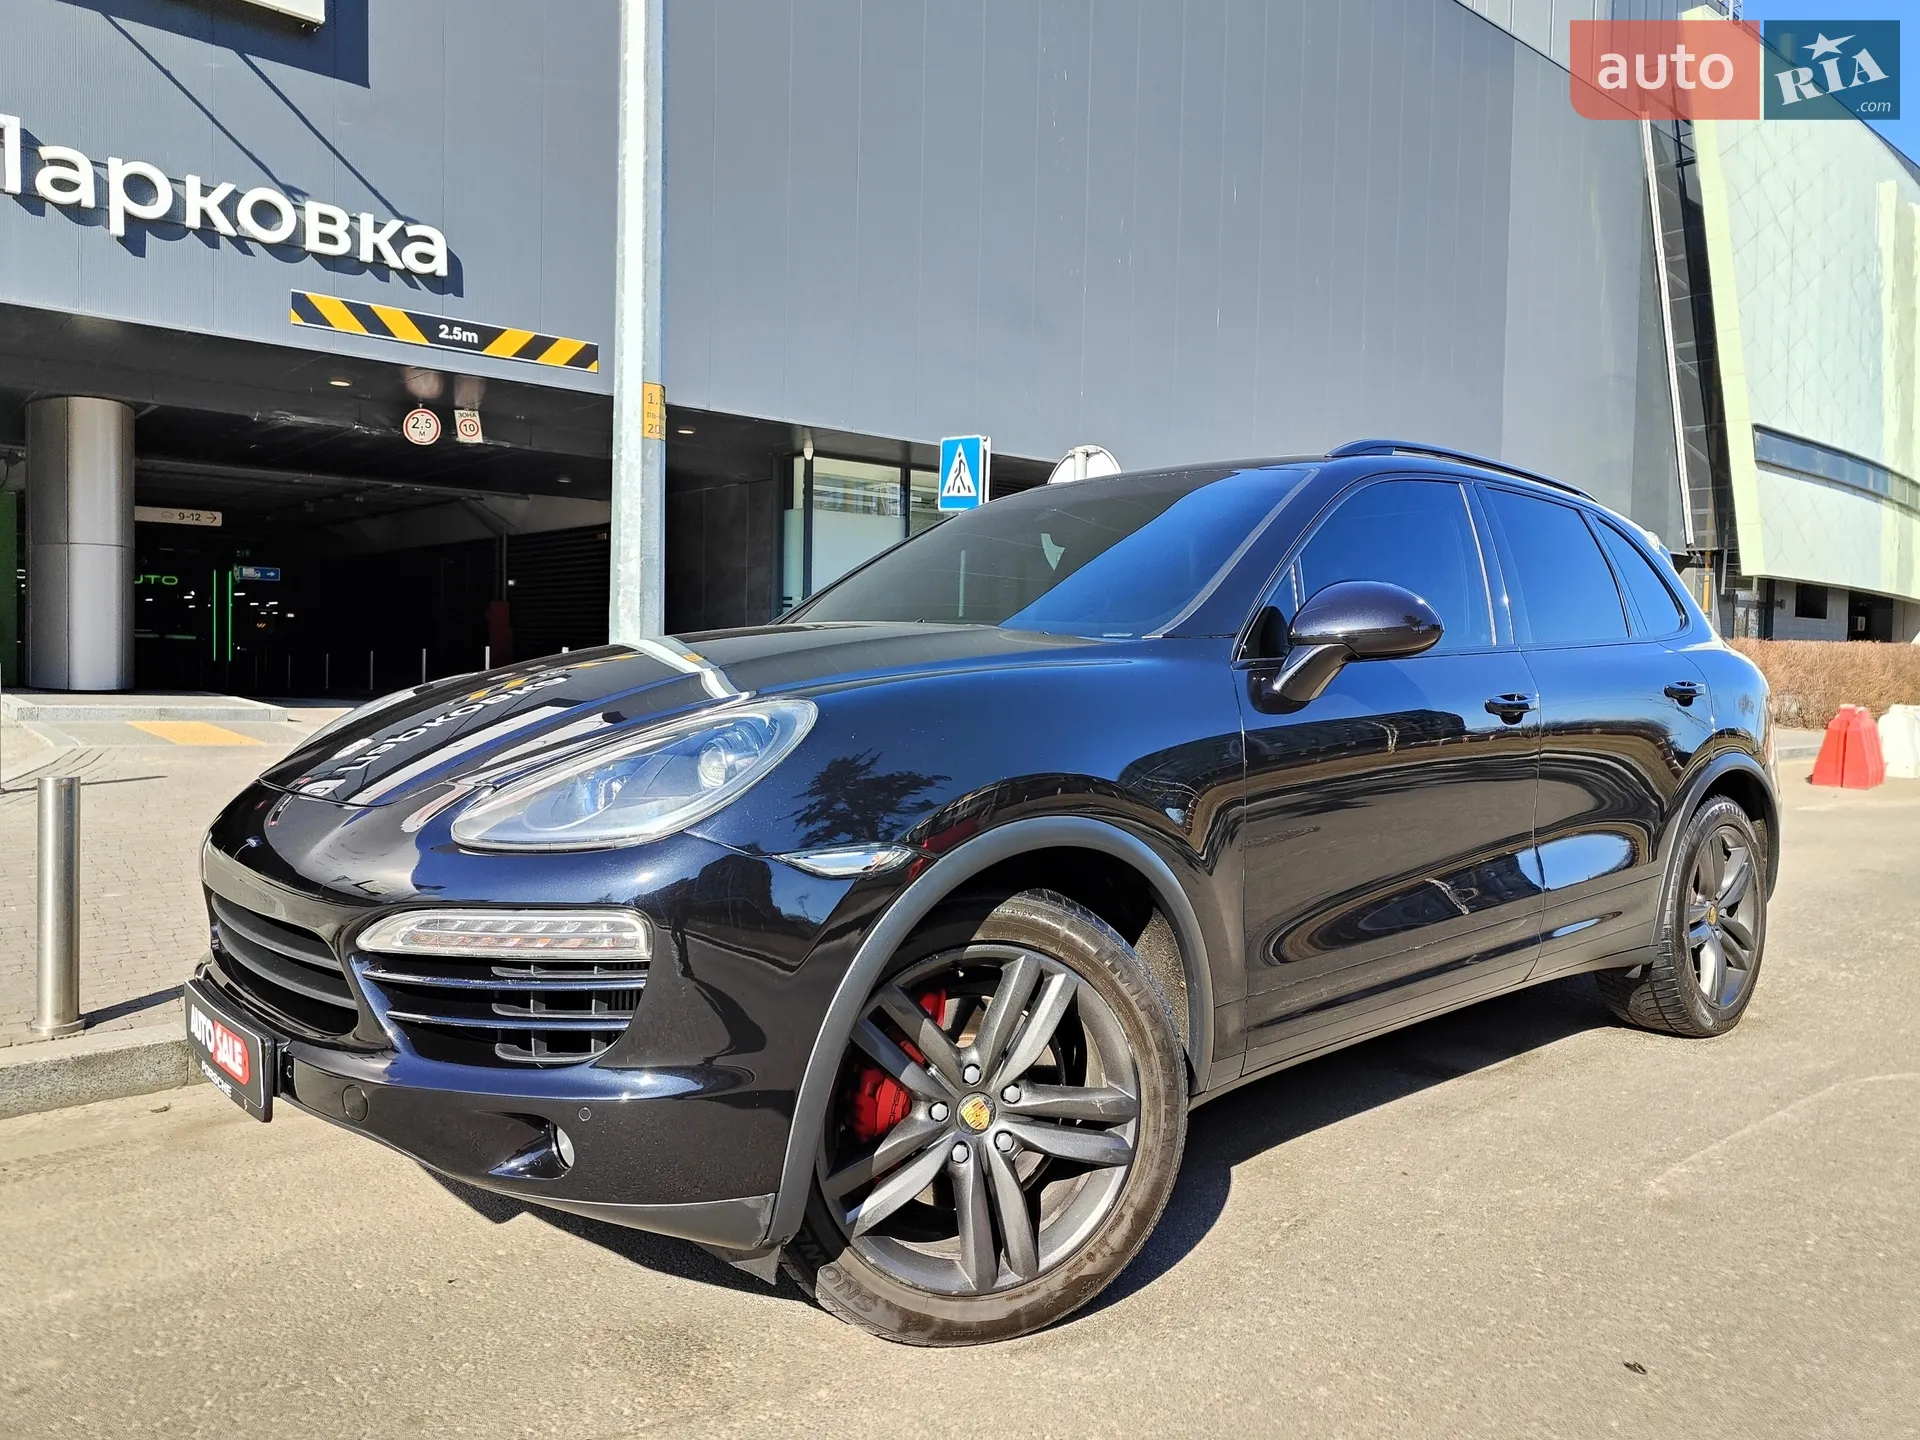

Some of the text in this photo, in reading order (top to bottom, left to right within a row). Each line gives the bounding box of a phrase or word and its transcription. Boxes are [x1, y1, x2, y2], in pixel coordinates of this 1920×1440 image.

[438, 323, 479, 344] 2.5m
[411, 416, 432, 430] 2,5
[463, 423, 476, 432] 10
[178, 511, 202, 522] 9-12
[190, 1003, 243, 1078] AUTO SALE
[201, 1060, 232, 1098] PORSCHE
